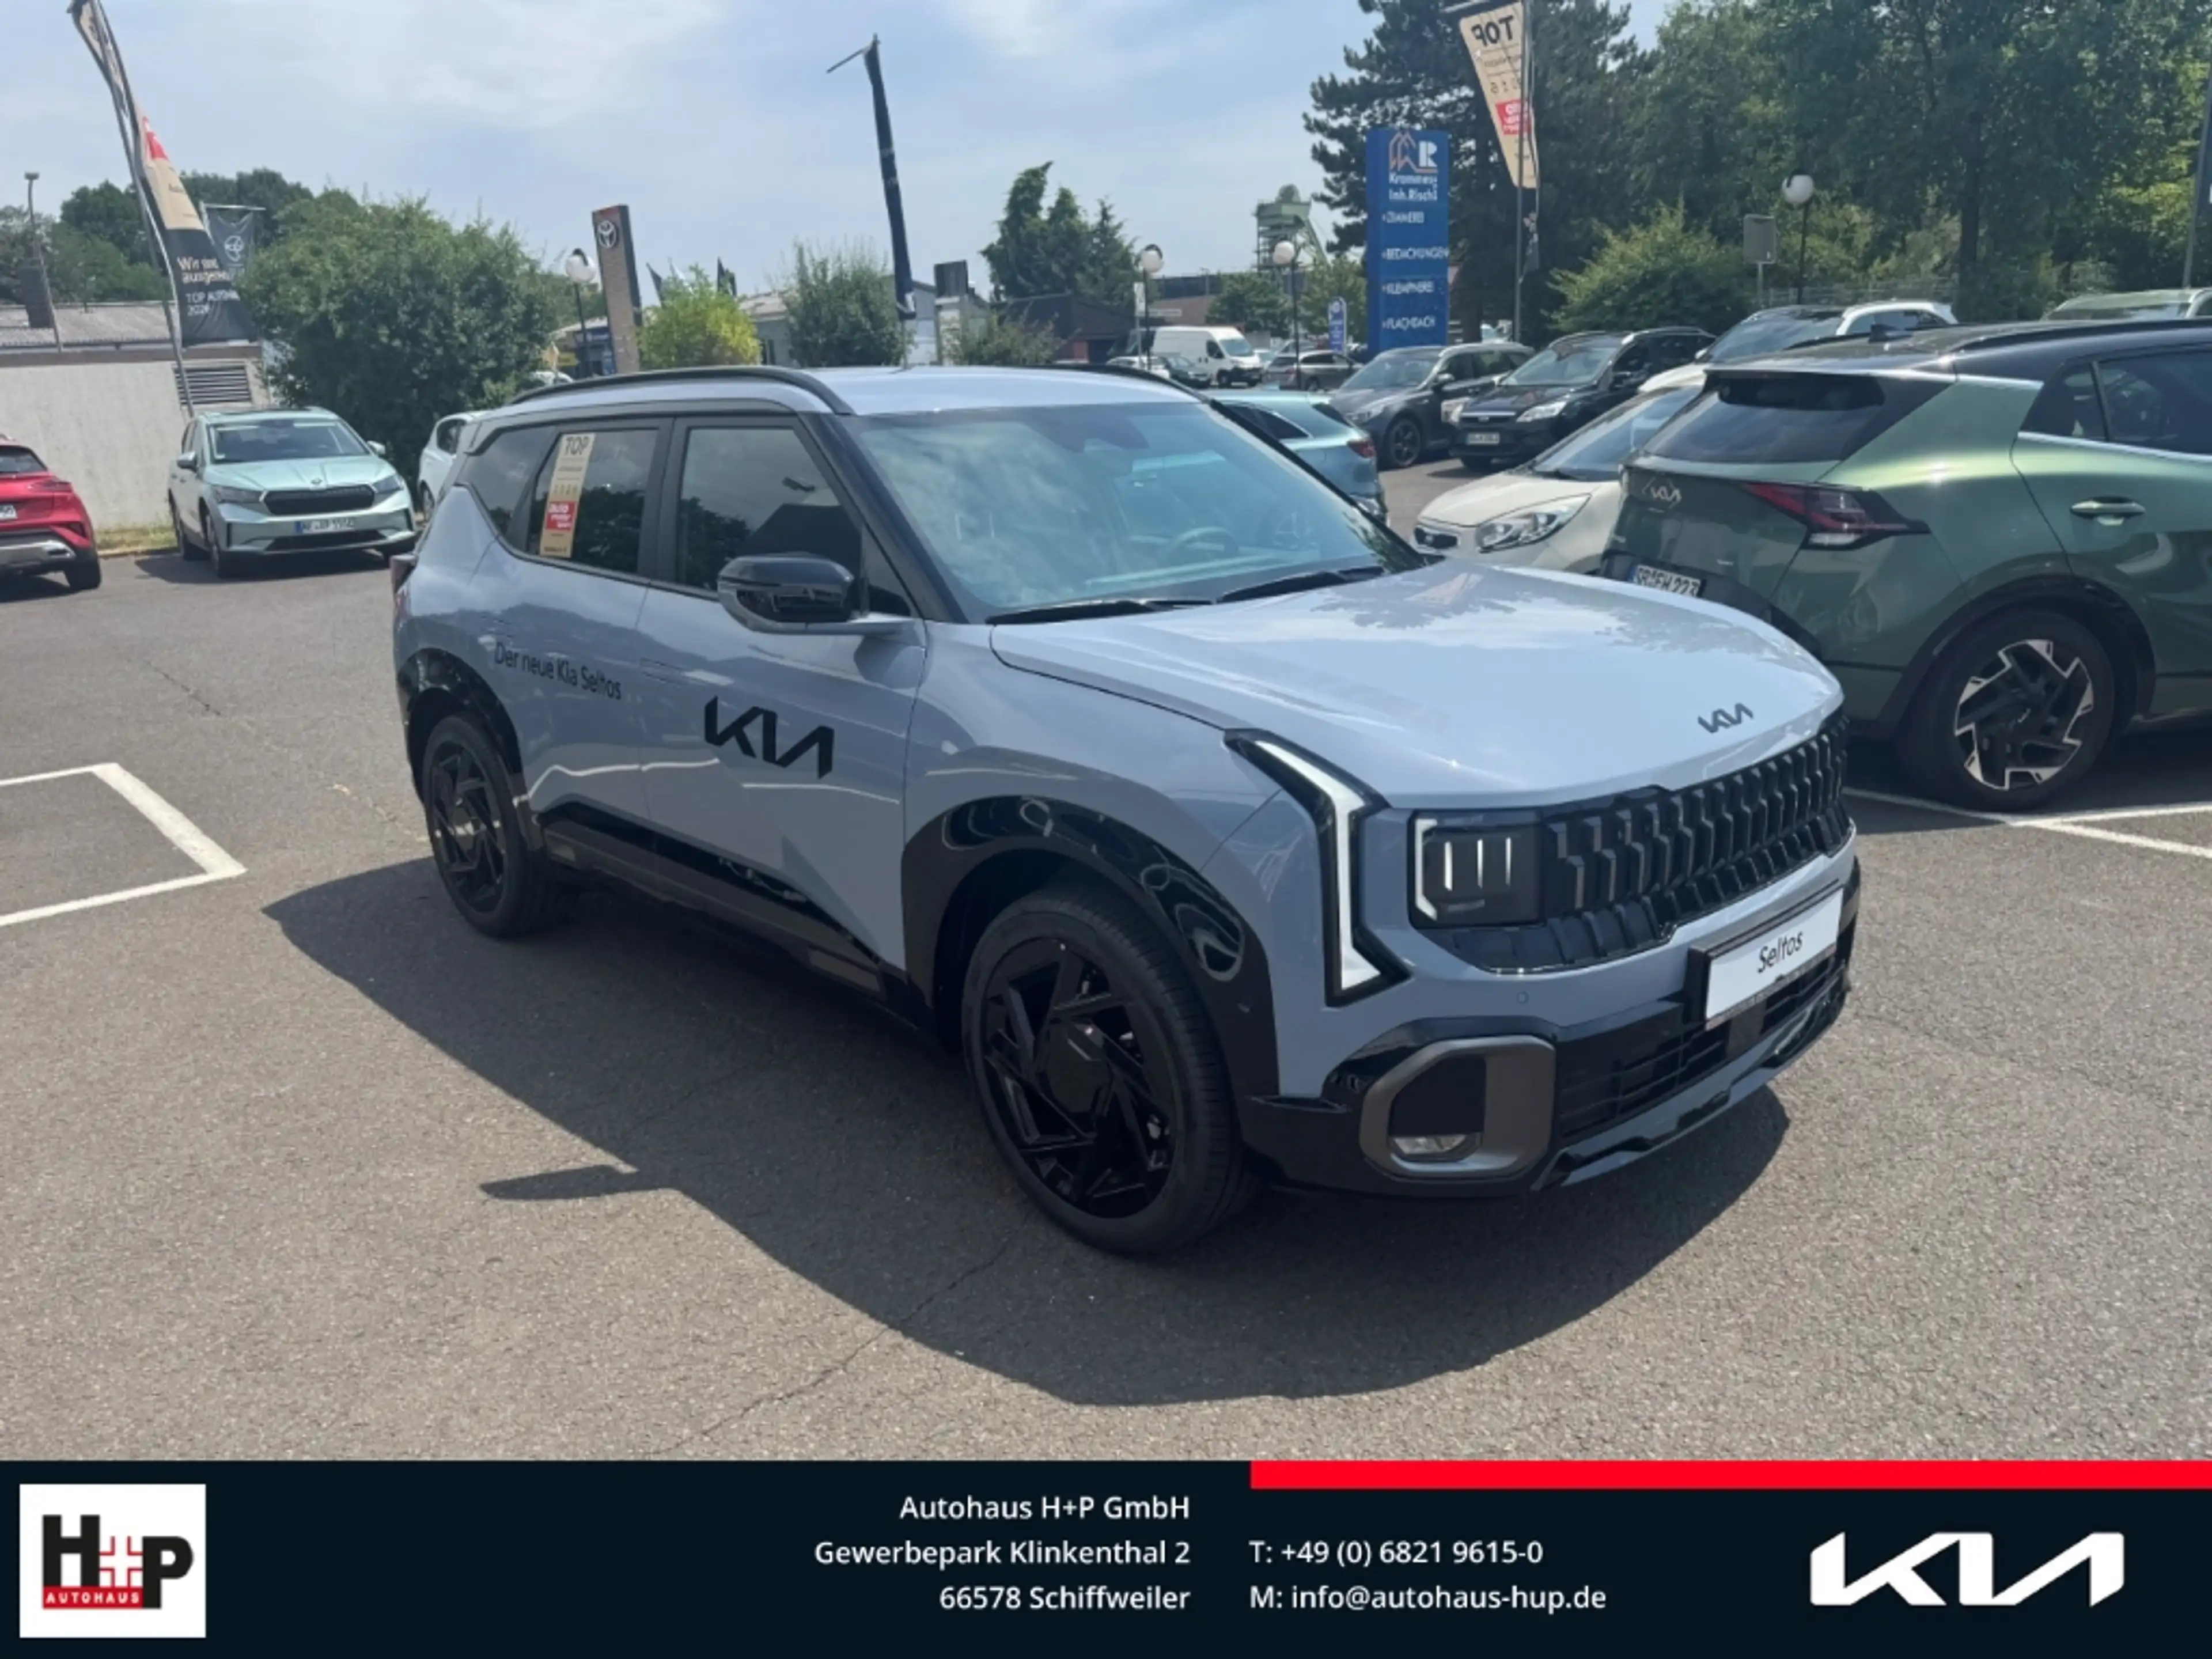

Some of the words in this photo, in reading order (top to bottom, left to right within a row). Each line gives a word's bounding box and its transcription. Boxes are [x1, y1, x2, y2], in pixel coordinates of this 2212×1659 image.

[565, 436, 590, 456] TOP
[495, 641, 518, 668] Der
[522, 654, 554, 680] neue
[557, 658, 578, 687] Kia
[581, 665, 622, 701] Seltos
[1757, 931, 1803, 974] Seltos
